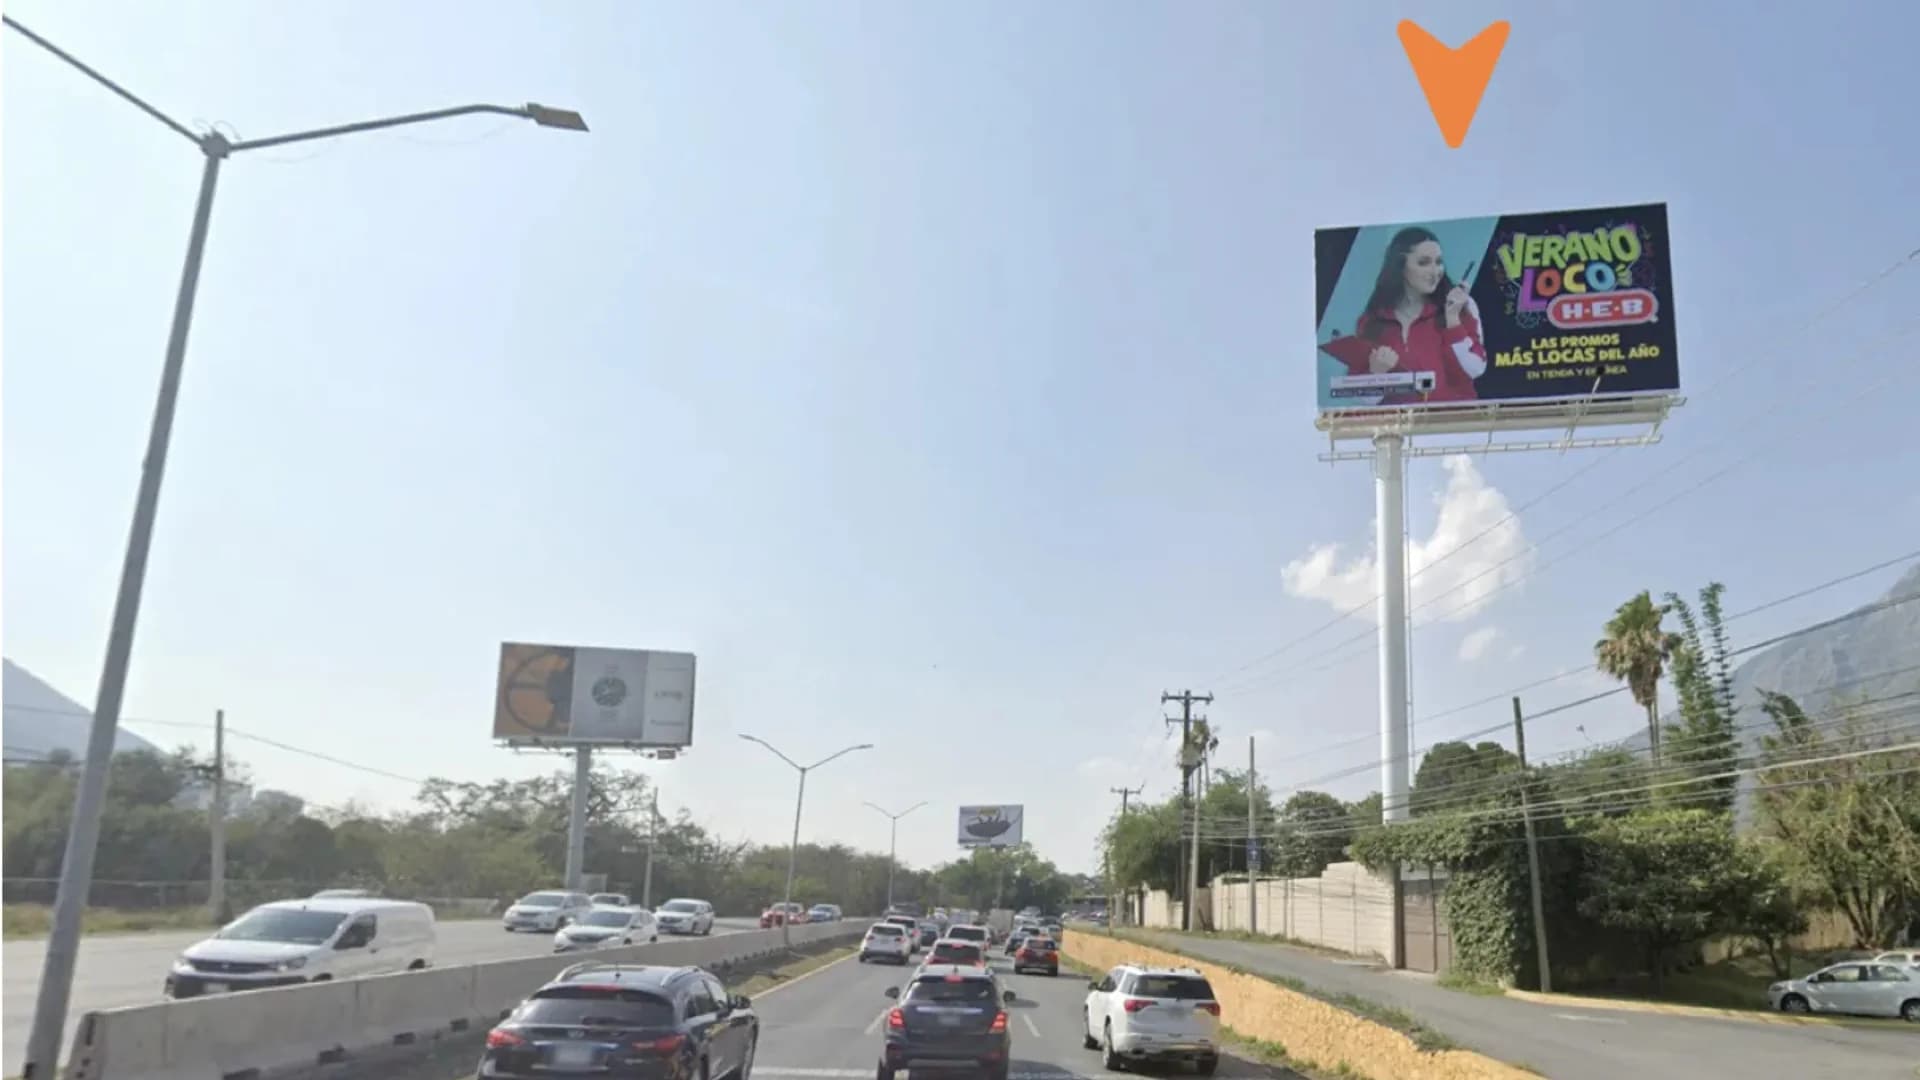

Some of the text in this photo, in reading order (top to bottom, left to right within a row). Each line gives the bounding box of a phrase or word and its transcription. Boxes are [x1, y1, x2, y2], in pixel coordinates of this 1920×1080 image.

[1498, 226, 1641, 279] VERANO
[1517, 262, 1616, 312] LOCO
[1531, 333, 1620, 350] LAS PROMOS
[1495, 343, 1660, 367] MÁS LOCAS DEL AÑO
[1527, 370, 1540, 380] EN
[1542, 368, 1575, 379] TIENDA
[1576, 367, 1584, 376] Y
